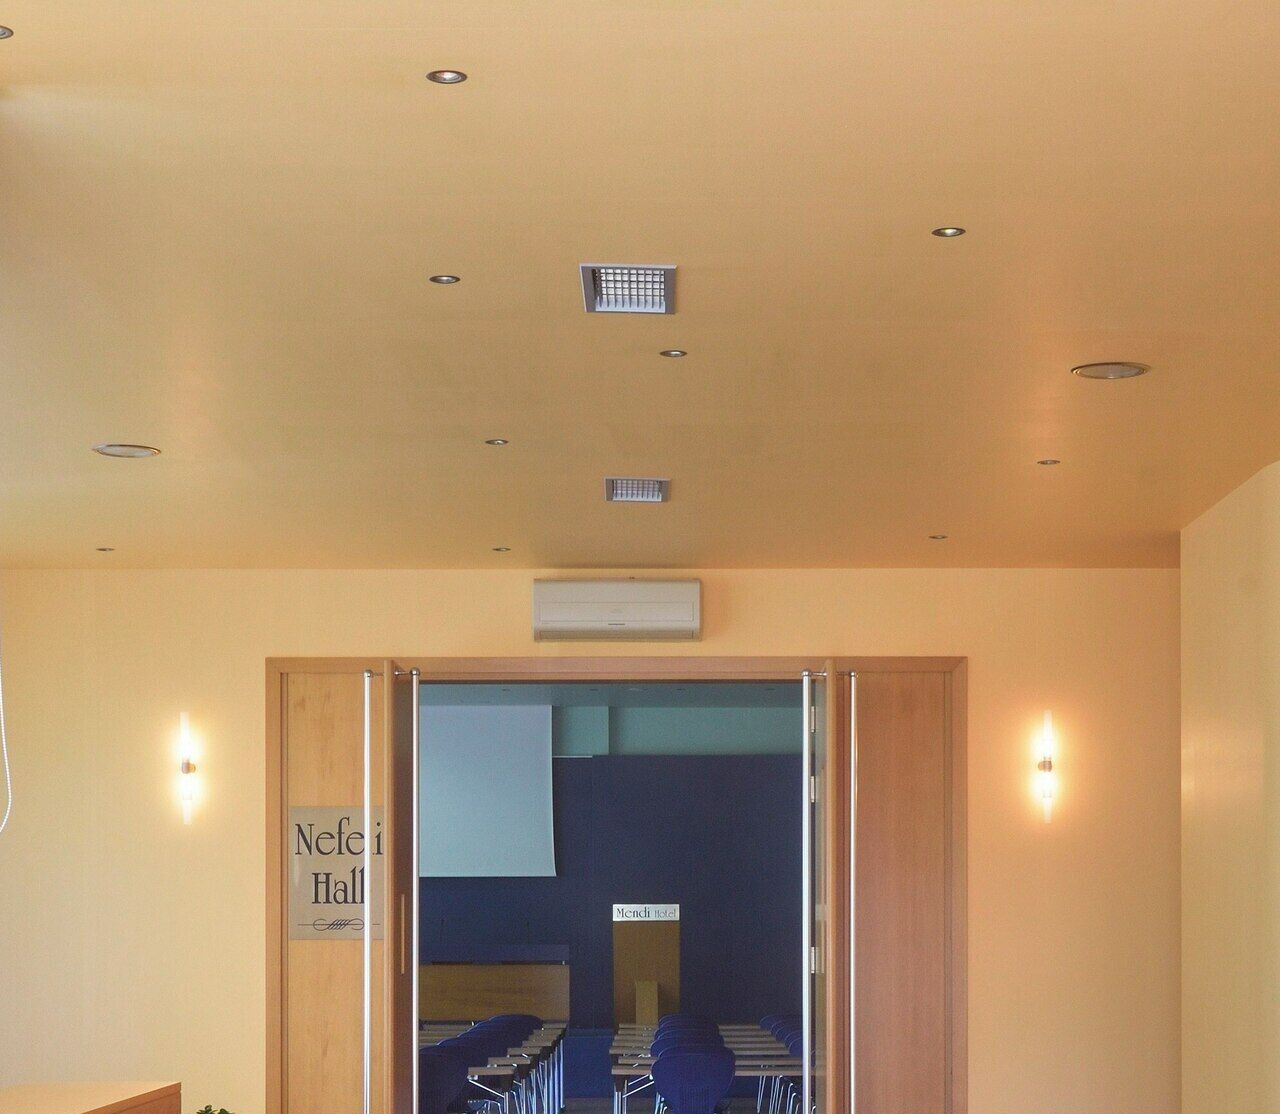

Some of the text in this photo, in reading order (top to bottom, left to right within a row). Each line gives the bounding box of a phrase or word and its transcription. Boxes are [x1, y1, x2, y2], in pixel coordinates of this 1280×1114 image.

[295, 817, 383, 855] Nefei
[312, 866, 365, 904] Hall
[616, 906, 676, 918] Mendi Hotel
